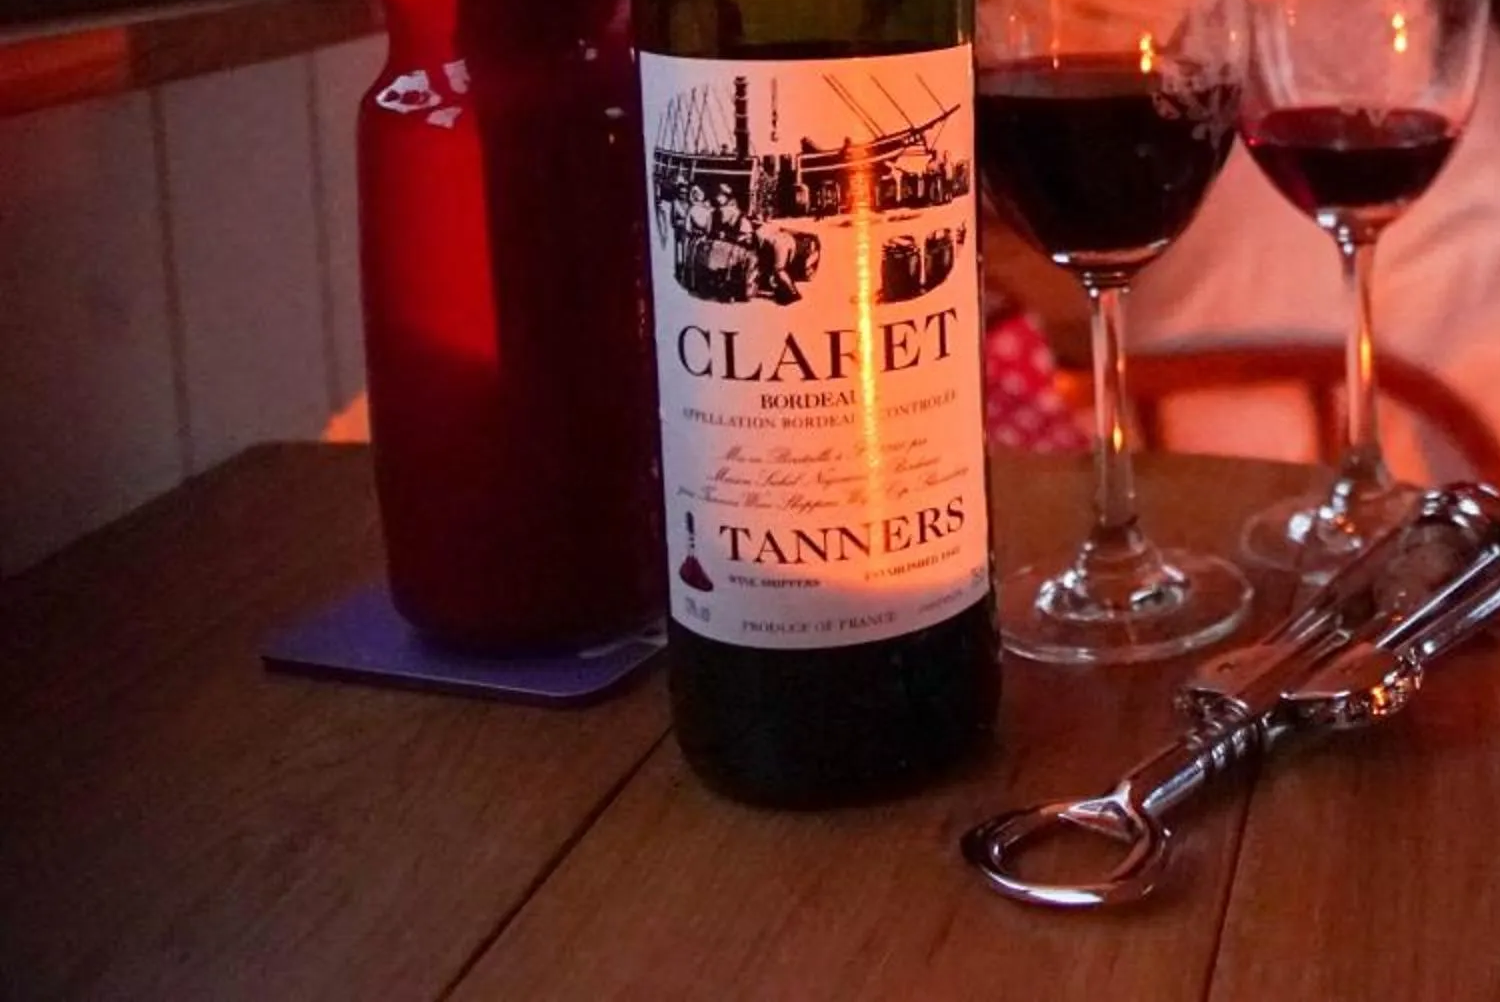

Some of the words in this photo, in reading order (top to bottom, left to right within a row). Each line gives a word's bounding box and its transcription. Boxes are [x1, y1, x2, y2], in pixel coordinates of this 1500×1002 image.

[677, 308, 959, 383] CLARET
[761, 389, 858, 409] BORDEA
[719, 495, 965, 564] TANNERS
